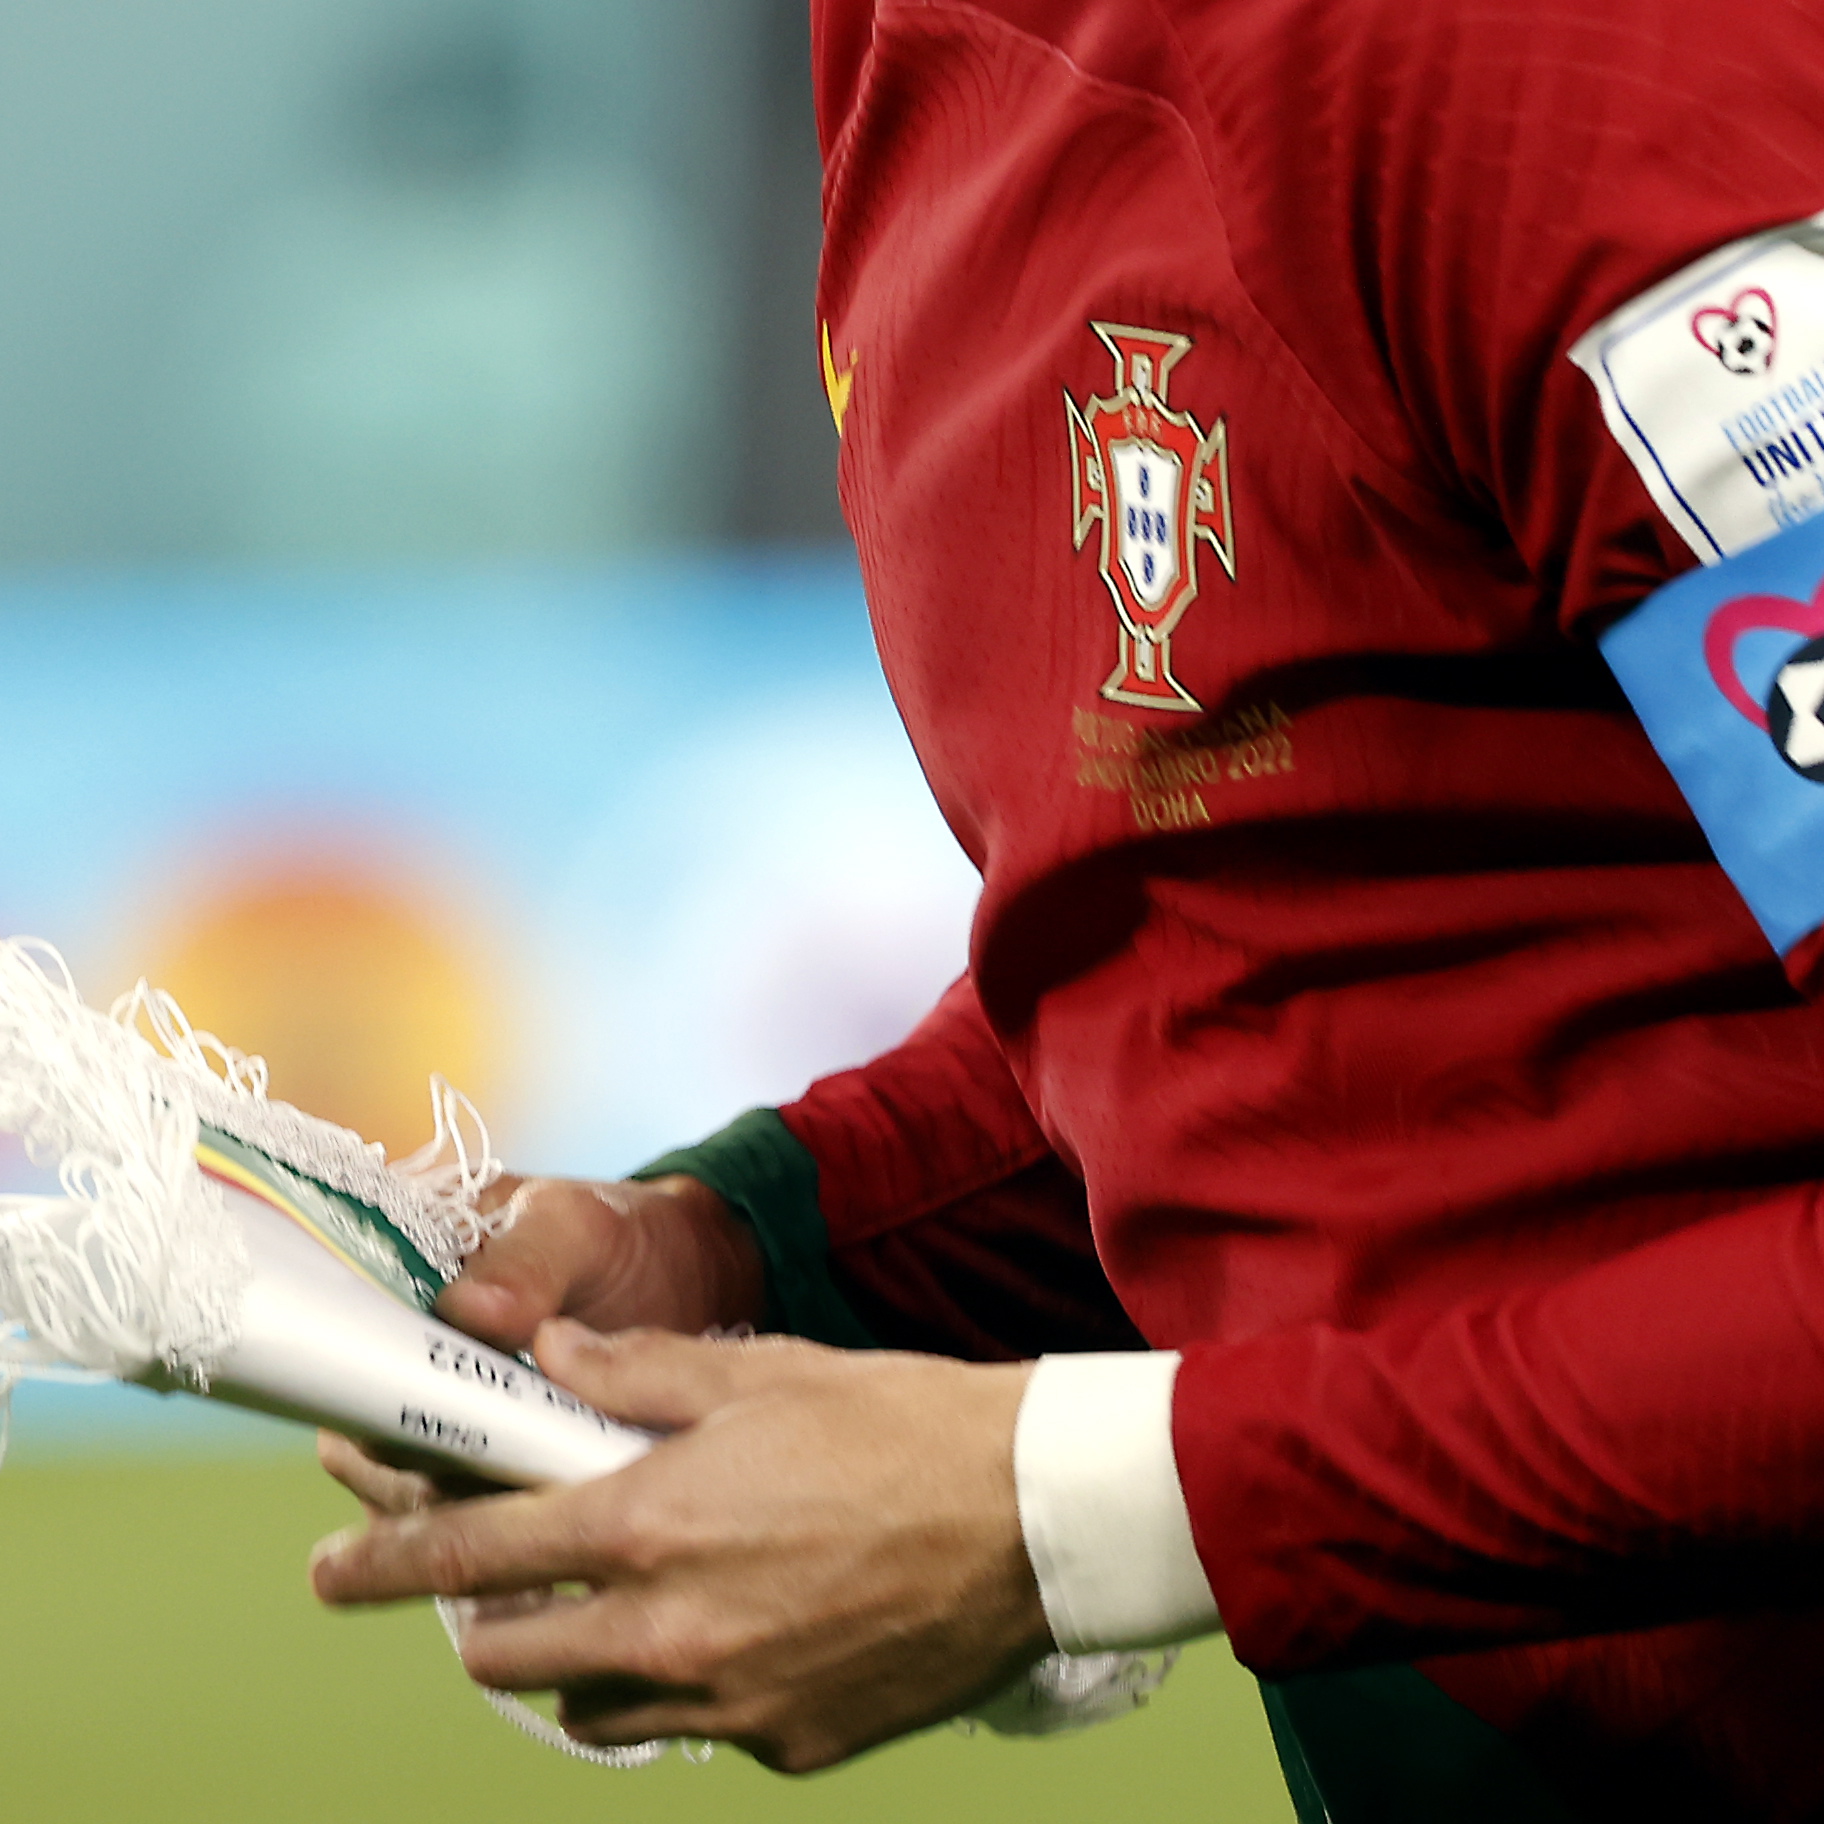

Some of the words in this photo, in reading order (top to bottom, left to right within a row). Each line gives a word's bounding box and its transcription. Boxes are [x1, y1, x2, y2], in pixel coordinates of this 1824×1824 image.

[1226, 732, 1297, 782] 2022
[1128, 787, 1212, 833] DOHA
[425, 1331, 523, 1401] 2022
